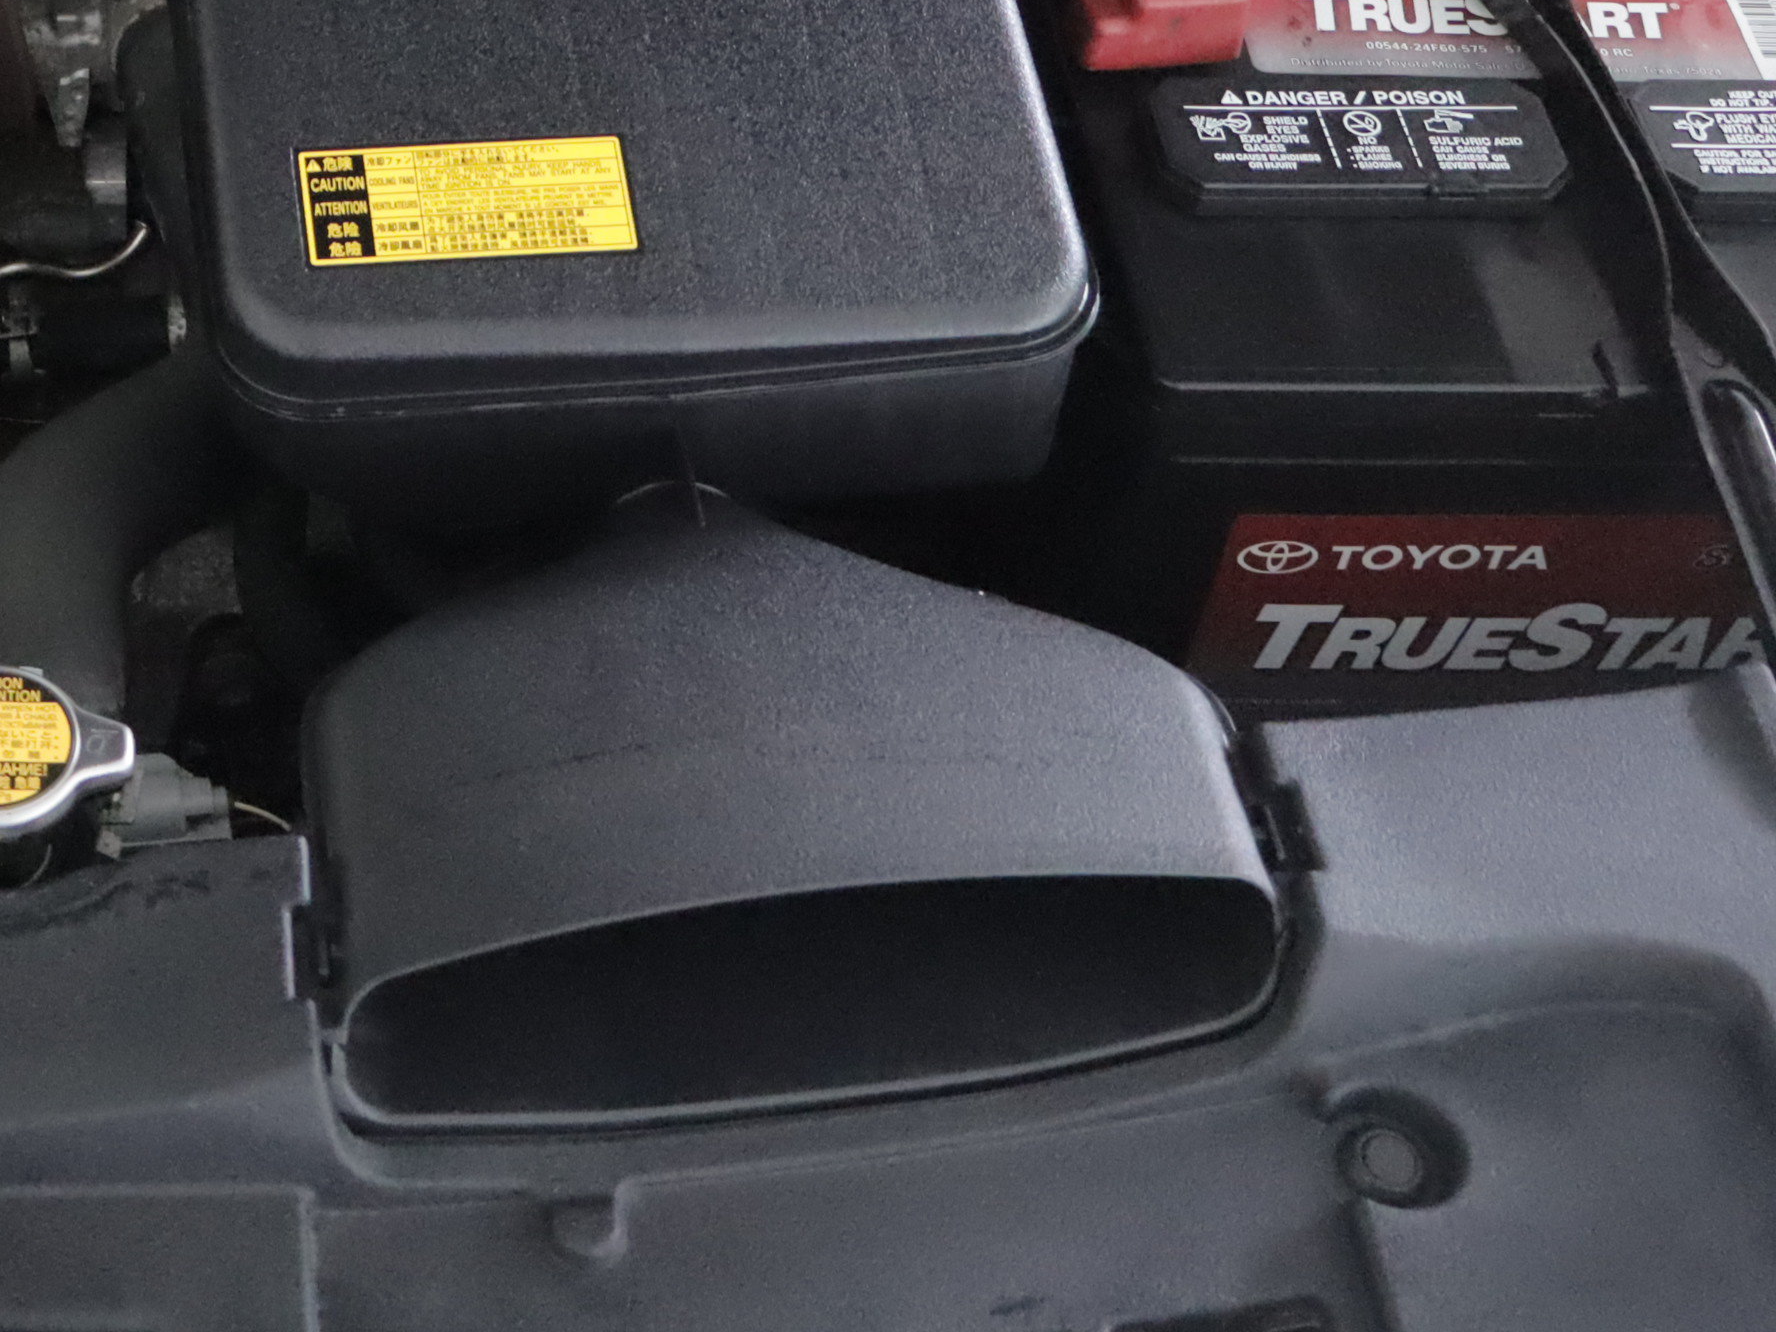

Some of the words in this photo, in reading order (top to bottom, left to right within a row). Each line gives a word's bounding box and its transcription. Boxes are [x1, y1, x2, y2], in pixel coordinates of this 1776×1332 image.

[1612, 48, 1633, 57] RC
[1291, 57, 1363, 69] Distributed
[1367, 59, 1382, 71] by
[1385, 58, 1428, 70] Toyota
[1245, 90, 1349, 105] DANGER
[1372, 90, 1466, 105] POISON
[1727, 90, 1756, 99] KEEP
[1709, 98, 1726, 107] DO
[1727, 98, 1751, 107] NOT
[1263, 116, 1309, 126] SHIELD
[1714, 113, 1757, 124] FLUSH
[1265, 125, 1300, 134] EYES
[1719, 124, 1755, 134] WITH
[1239, 134, 1310, 144] EXPLOSIVE
[1357, 136, 1377, 145] NO
[1428, 136, 1491, 146] SULFURIC
[1494, 136, 1523, 146] ACID
[1243, 143, 1287, 153] GASES
[1432, 146, 1453, 154] CAN
[1456, 146, 1489, 154] CAUSE
[1214, 153, 1236, 161] CAN
[1236, 153, 1268, 162] CAUSE
[1268, 153, 1322, 163] BLINDNESS
[1355, 153, 1394, 161] FLAMES
[1248, 161, 1264, 170] OR
[1264, 161, 1298, 170] INJURY
[1358, 161, 1403, 169] SMOKING
[1438, 161, 1477, 170] SEVERE
[1477, 161, 1511, 170] BURNS
[1711, 165, 1733, 174] NOT
[310, 176, 365, 193] CAUTION
[369, 177, 396, 186] COOLING
[398, 175, 415, 185] FANS
[314, 200, 368, 216] ATTENTION
[373, 200, 419, 210] VENTILATEURS
[1331, 544, 1548, 570] TOYOTA
[1252, 602, 1769, 671] TRUESTAR
